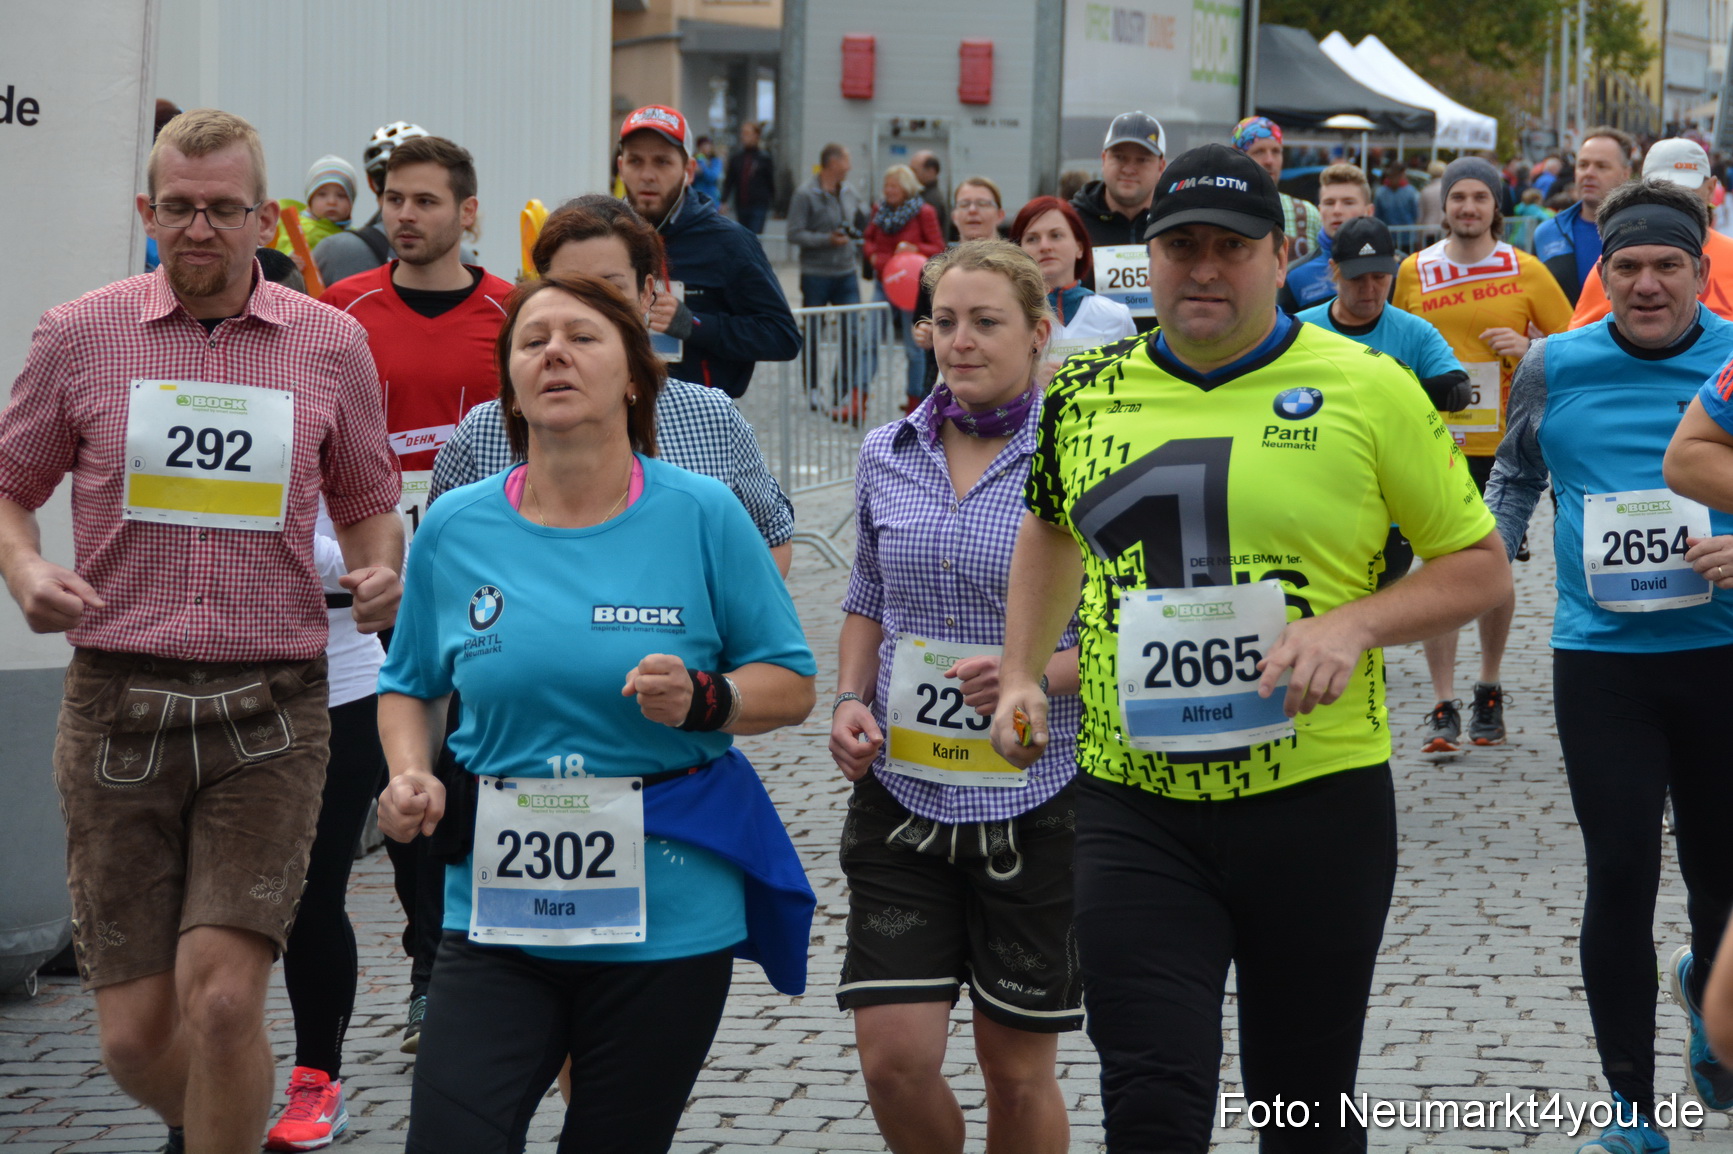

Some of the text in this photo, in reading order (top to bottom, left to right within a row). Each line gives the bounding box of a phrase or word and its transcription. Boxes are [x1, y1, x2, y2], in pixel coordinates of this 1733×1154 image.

[1216, 176, 1248, 192] DTM
[1107, 267, 1148, 289] 265
[1125, 295, 1148, 305] Sören
[1422, 282, 1523, 313] MAX BÖGL
[192, 395, 248, 411] BOCK
[406, 434, 437, 447] DEHN
[1263, 425, 1318, 443] Partl
[166, 425, 253, 472] 292
[1262, 440, 1316, 451] Neumarkt
[1627, 500, 1672, 514] BOCK
[1602, 525, 1690, 567] 2654
[1190, 554, 1302, 567] DER NEUE BMW 1er.
[1631, 577, 1667, 592] David
[592, 605, 685, 626] BOCK
[1178, 602, 1235, 617] BOCK
[464, 633, 502, 650] PARTL
[464, 645, 502, 658] Neumarkt
[1142, 634, 1263, 689] 2665
[1182, 703, 1233, 723] Alfred
[933, 742, 969, 760] Karin
[531, 795, 590, 808] BOCK
[497, 830, 616, 880] 2302
[534, 898, 576, 916] Mara
[998, 978, 1024, 992] ALPIN
